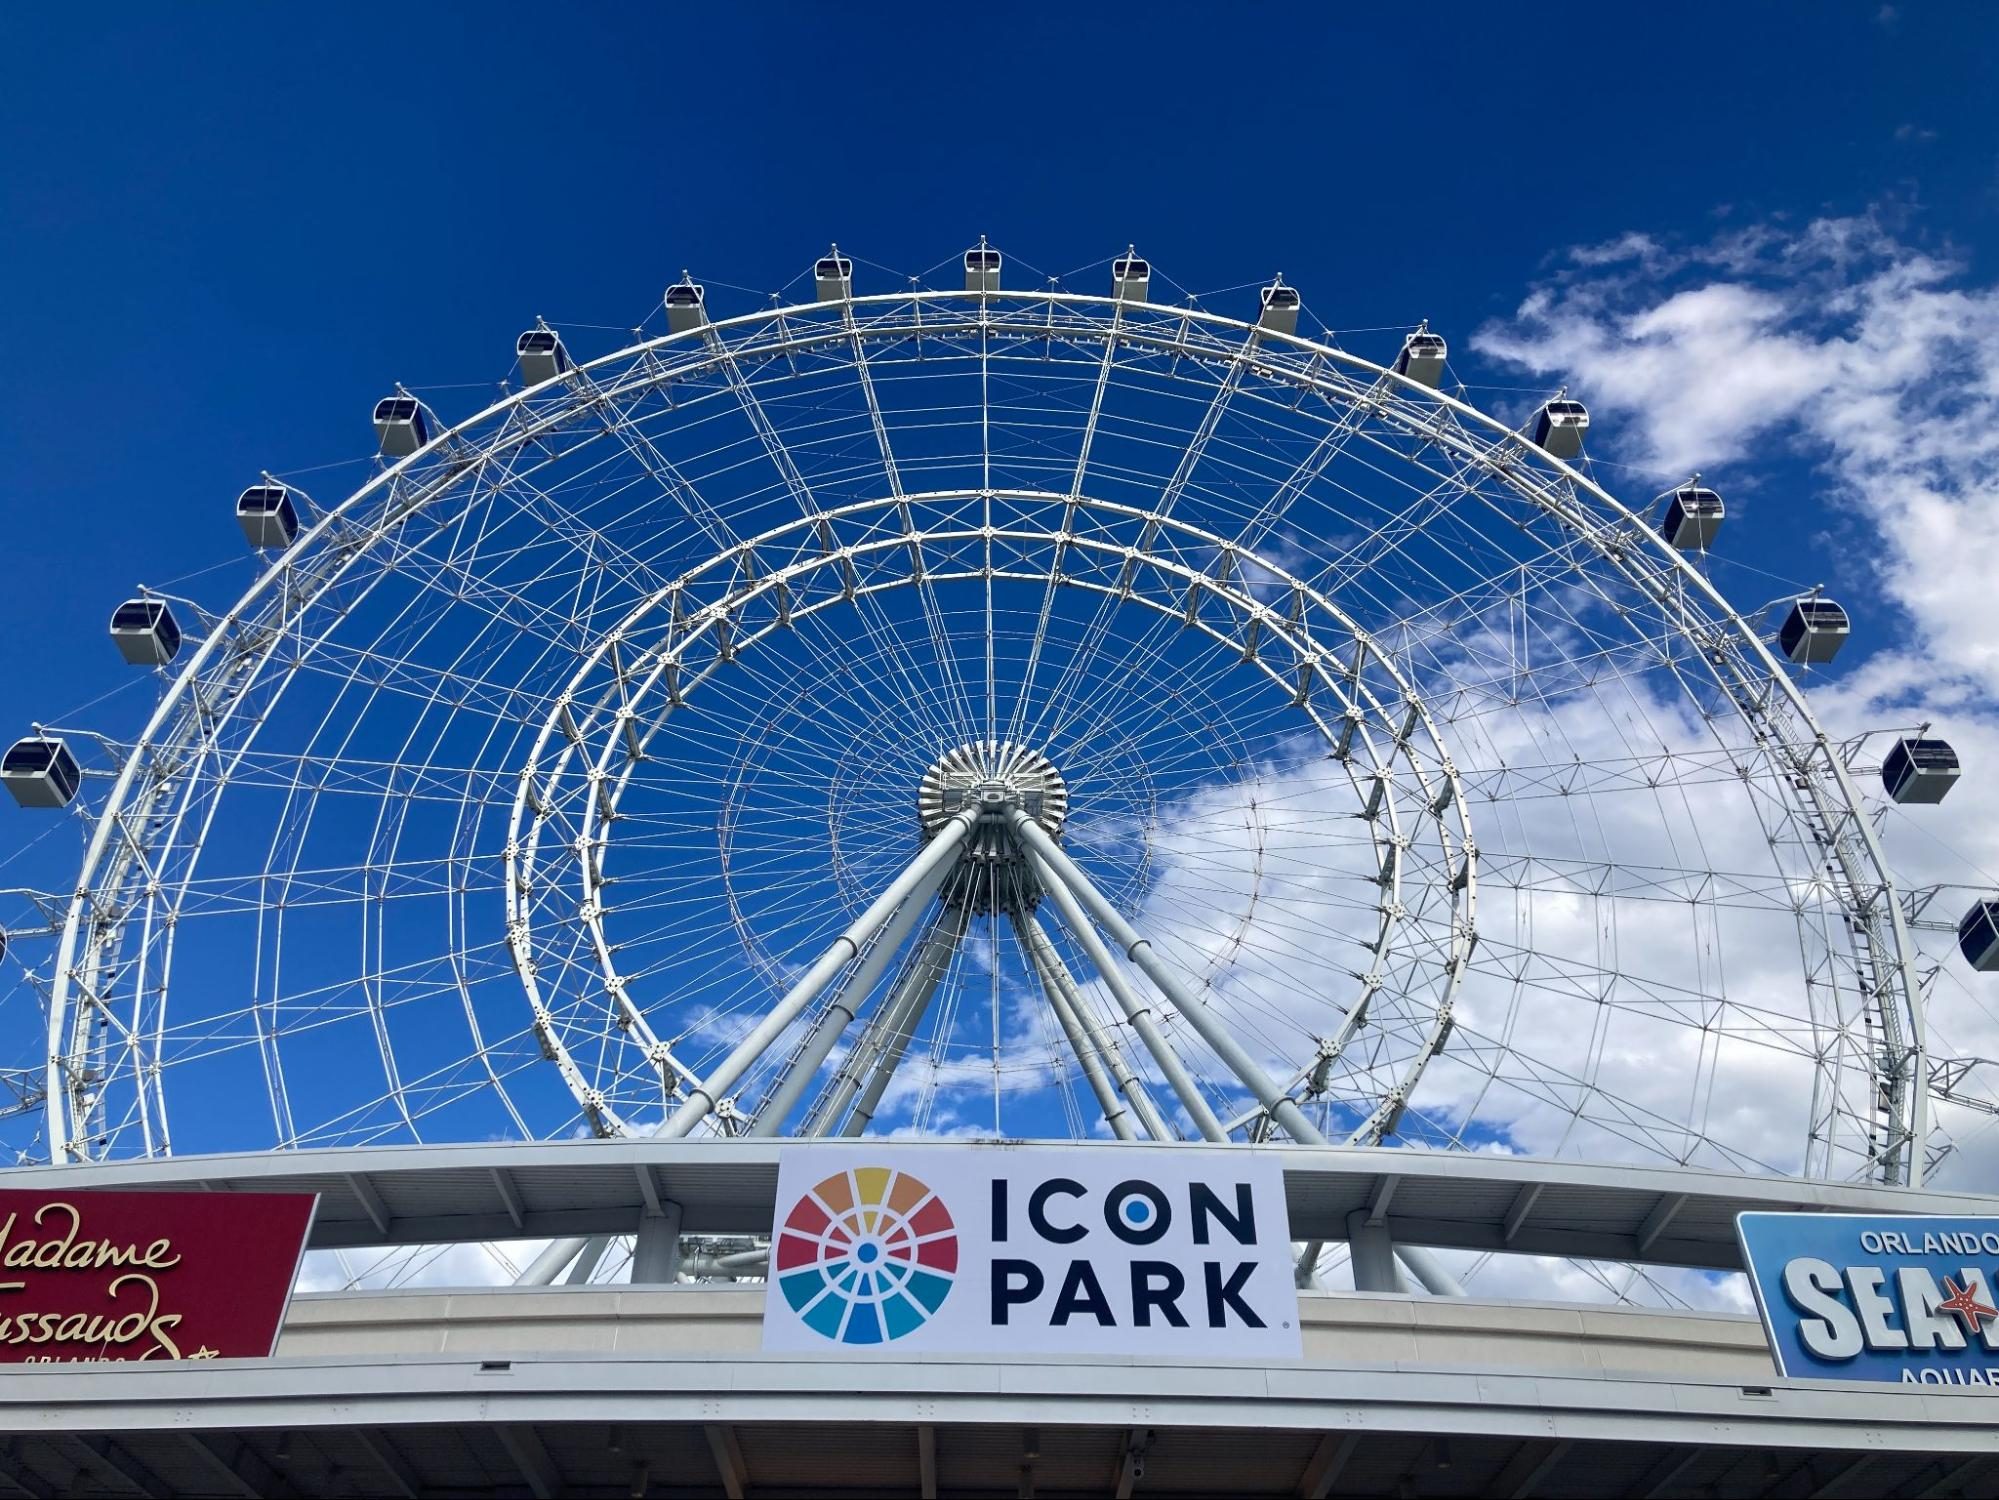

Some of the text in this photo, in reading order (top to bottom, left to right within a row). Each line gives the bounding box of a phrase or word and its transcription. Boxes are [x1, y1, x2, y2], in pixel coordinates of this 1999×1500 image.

[991, 1177, 1258, 1246] ICON
[1860, 1231, 1999, 1255] ORLANDO
[0, 1274, 183, 1360] ussauds
[991, 1258, 1269, 1329] PARK
